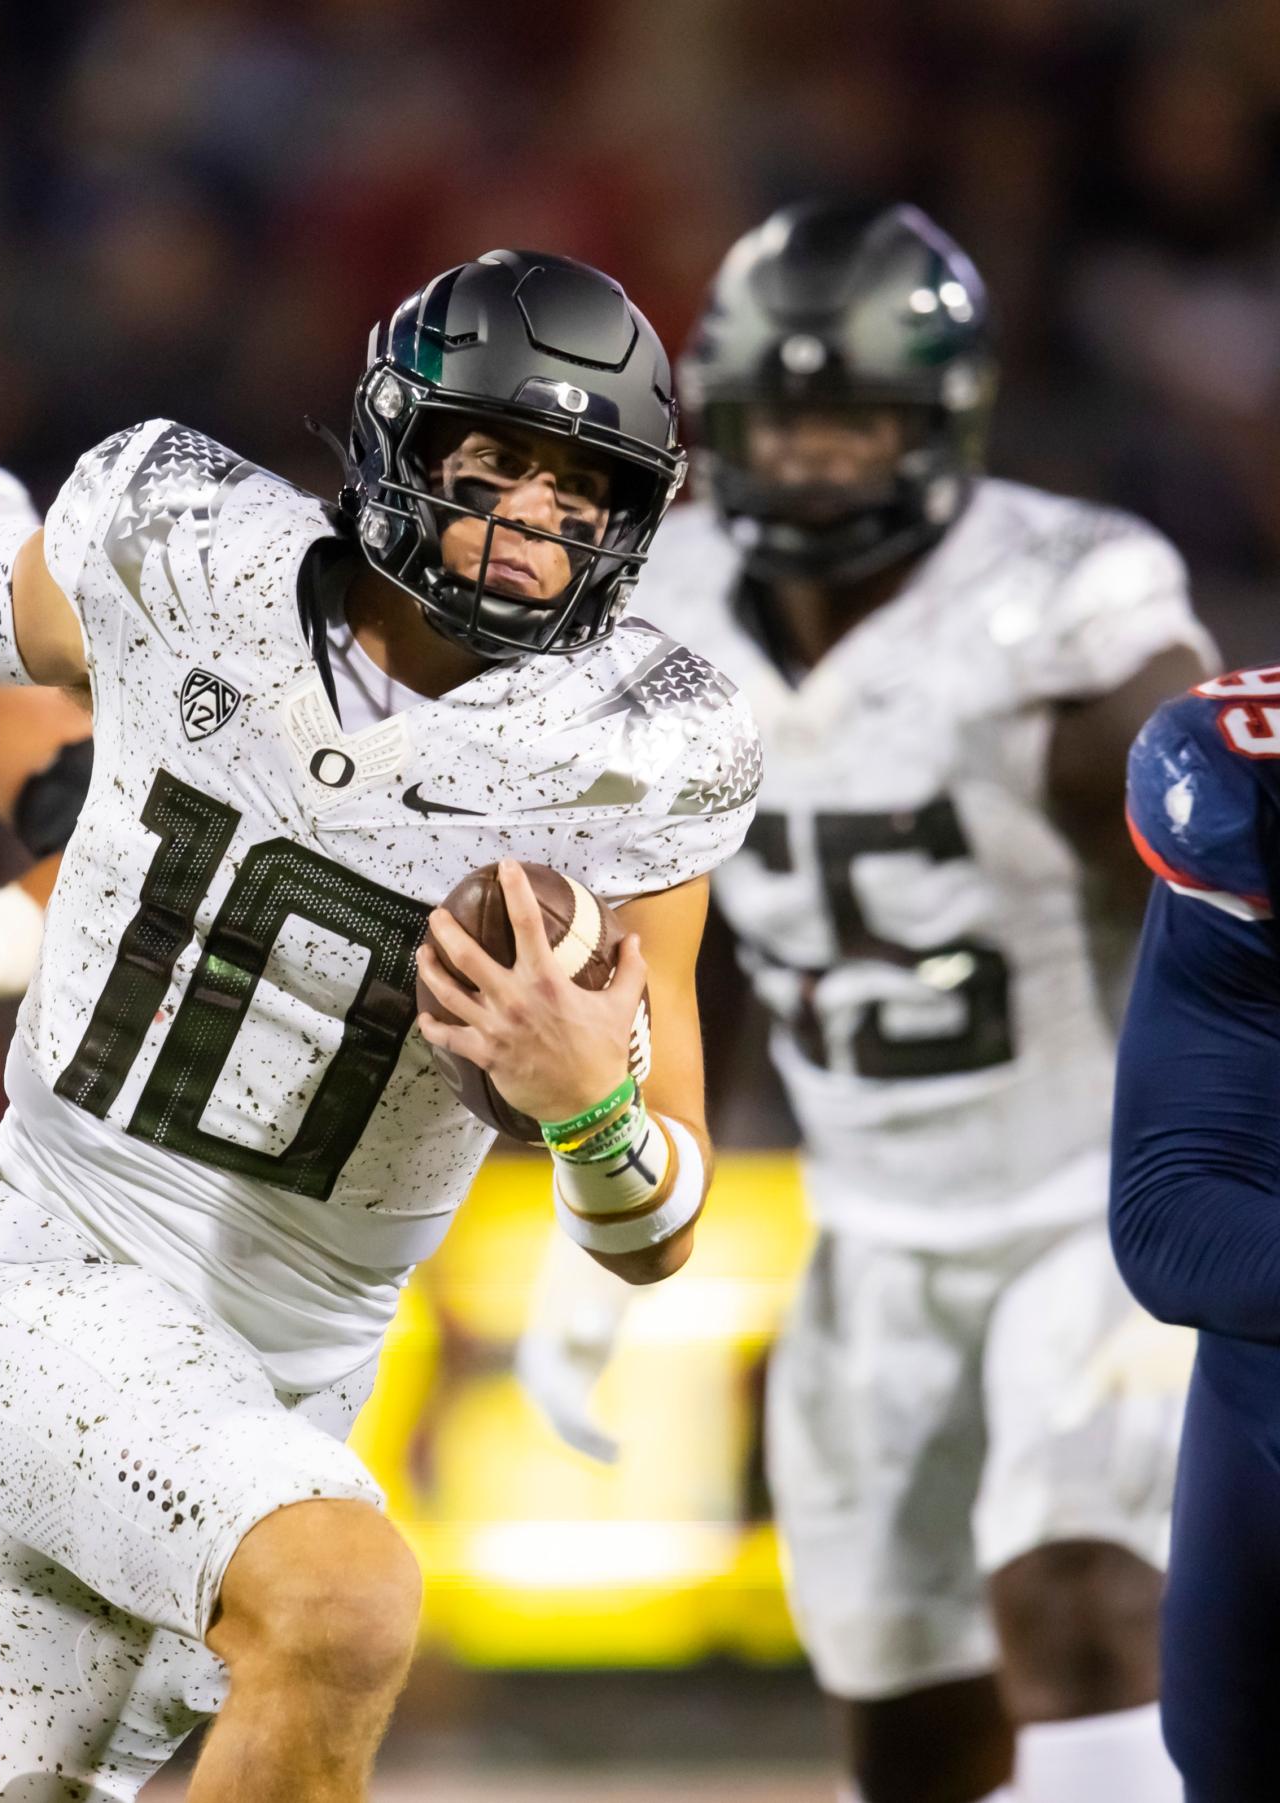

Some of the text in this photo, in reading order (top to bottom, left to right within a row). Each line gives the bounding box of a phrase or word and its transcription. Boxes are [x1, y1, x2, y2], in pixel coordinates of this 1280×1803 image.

[184, 673, 236, 724] PAC
[185, 701, 215, 732] 12
[310, 748, 355, 788] O
[53, 767, 434, 1202] 10
[594, 1095, 621, 1118] PLAY
